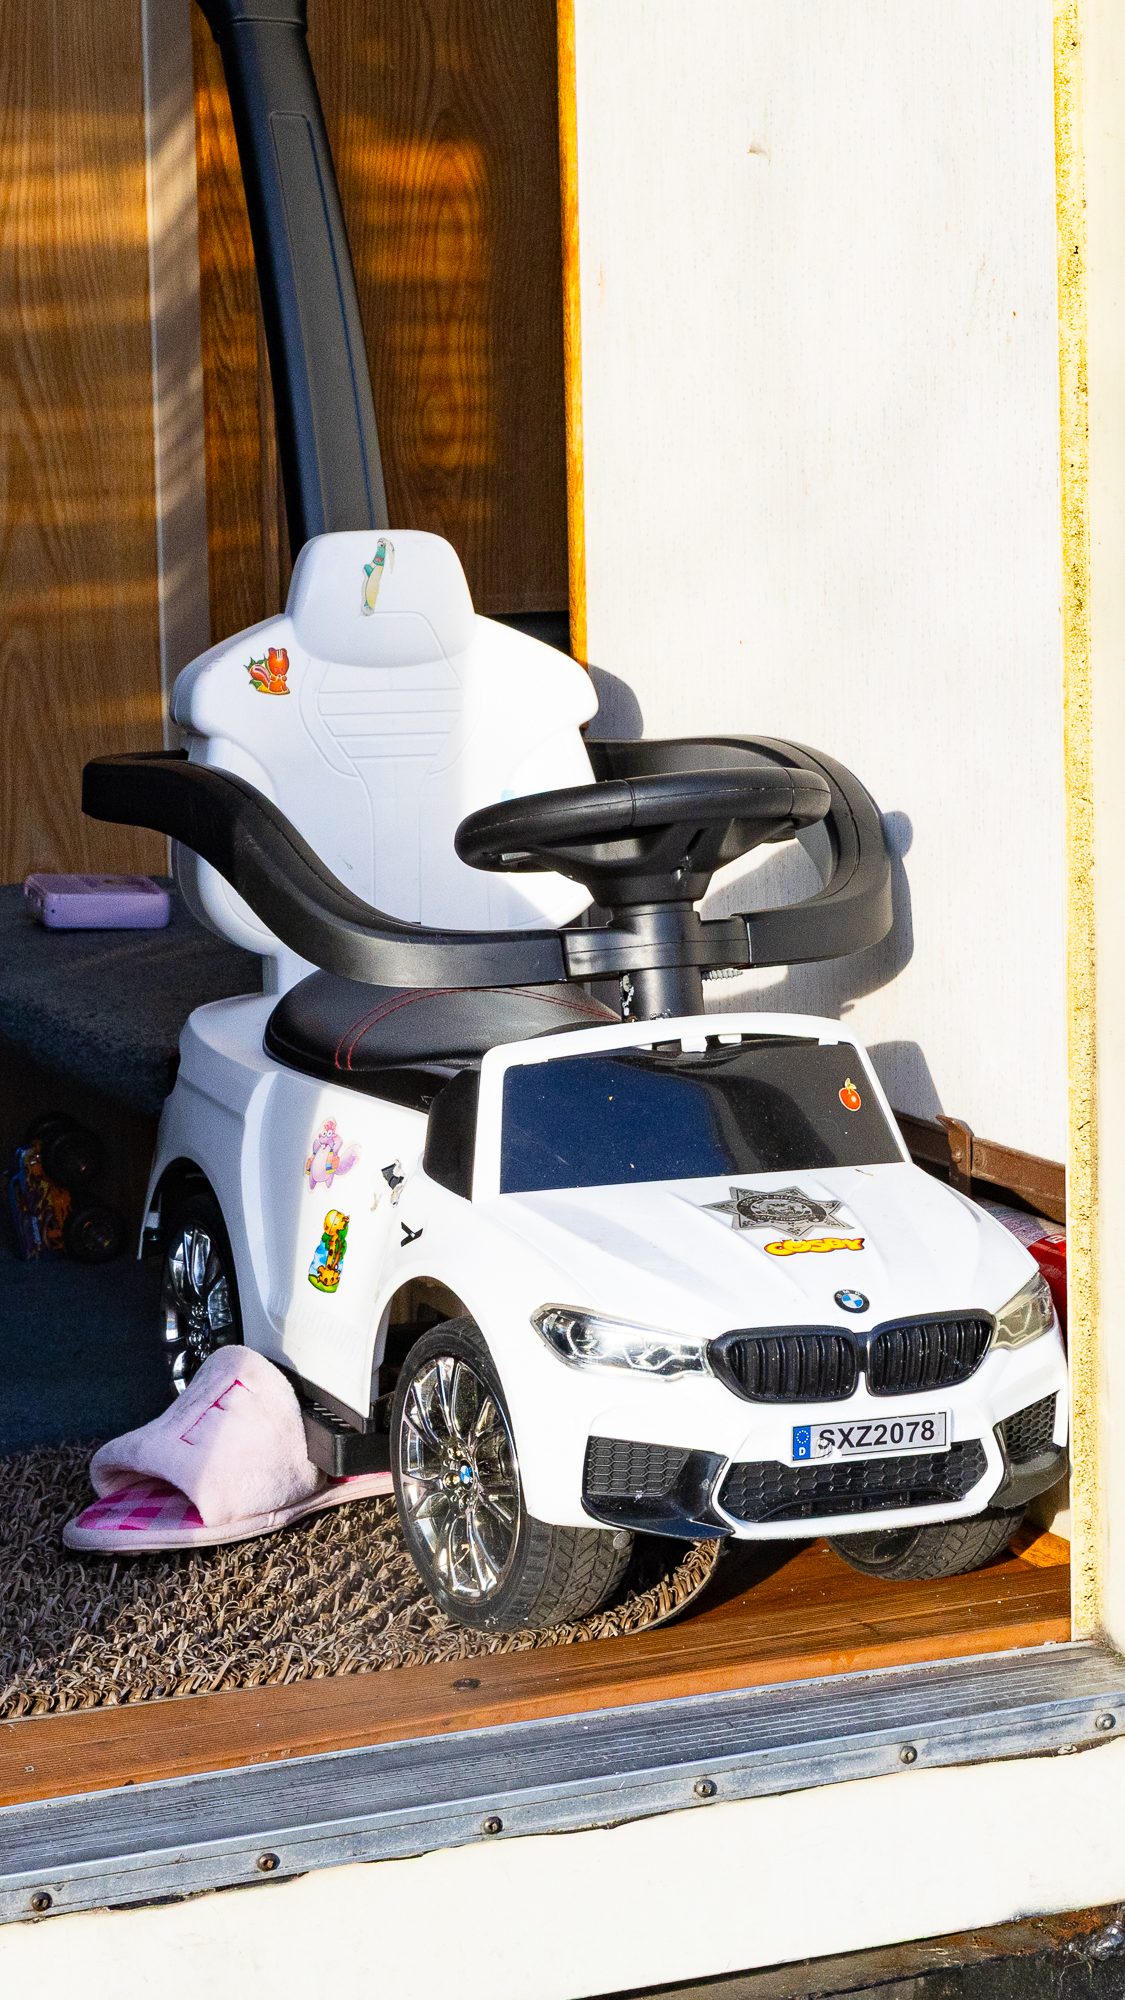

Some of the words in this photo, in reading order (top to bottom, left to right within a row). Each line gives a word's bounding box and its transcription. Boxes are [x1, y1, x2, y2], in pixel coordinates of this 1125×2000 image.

[764, 1237, 865, 1256] COSBY
[817, 1420, 935, 1450] SXZ2078
[798, 1447, 806, 1456] D
